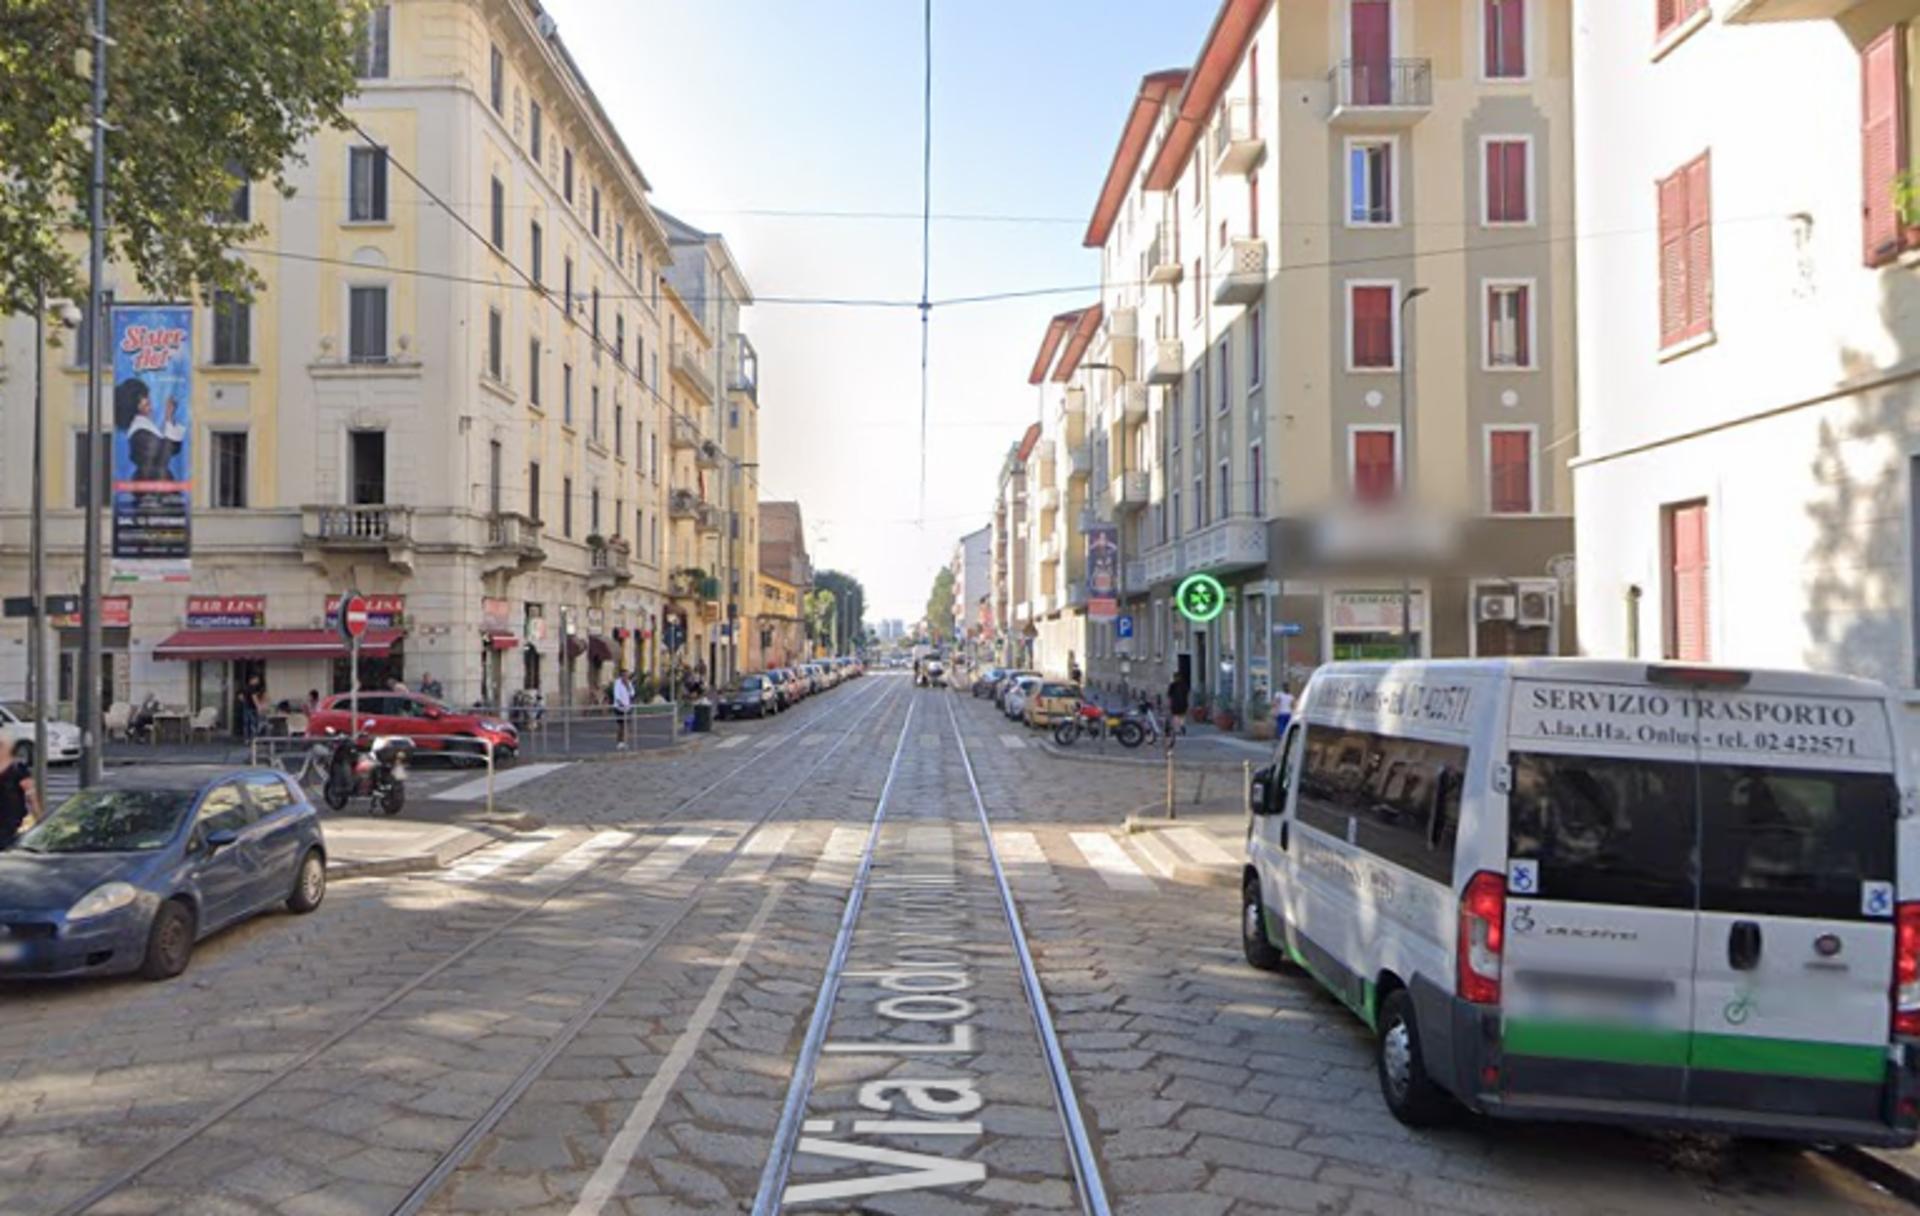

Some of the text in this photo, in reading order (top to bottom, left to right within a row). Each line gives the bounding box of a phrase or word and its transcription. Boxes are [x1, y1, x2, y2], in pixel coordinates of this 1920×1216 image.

[121, 326, 185, 352] Sister
[133, 347, 171, 371] Act
[190, 599, 263, 612] BAR LISA
[1120, 618, 1131, 632] P
[1532, 688, 1855, 728] SERVIZIO TRASPORTO
[1637, 725, 1699, 746] Onlus
[1718, 731, 1748, 749] tel.
[1755, 732, 1779, 751] 02
[1784, 735, 1856, 756] 422571
